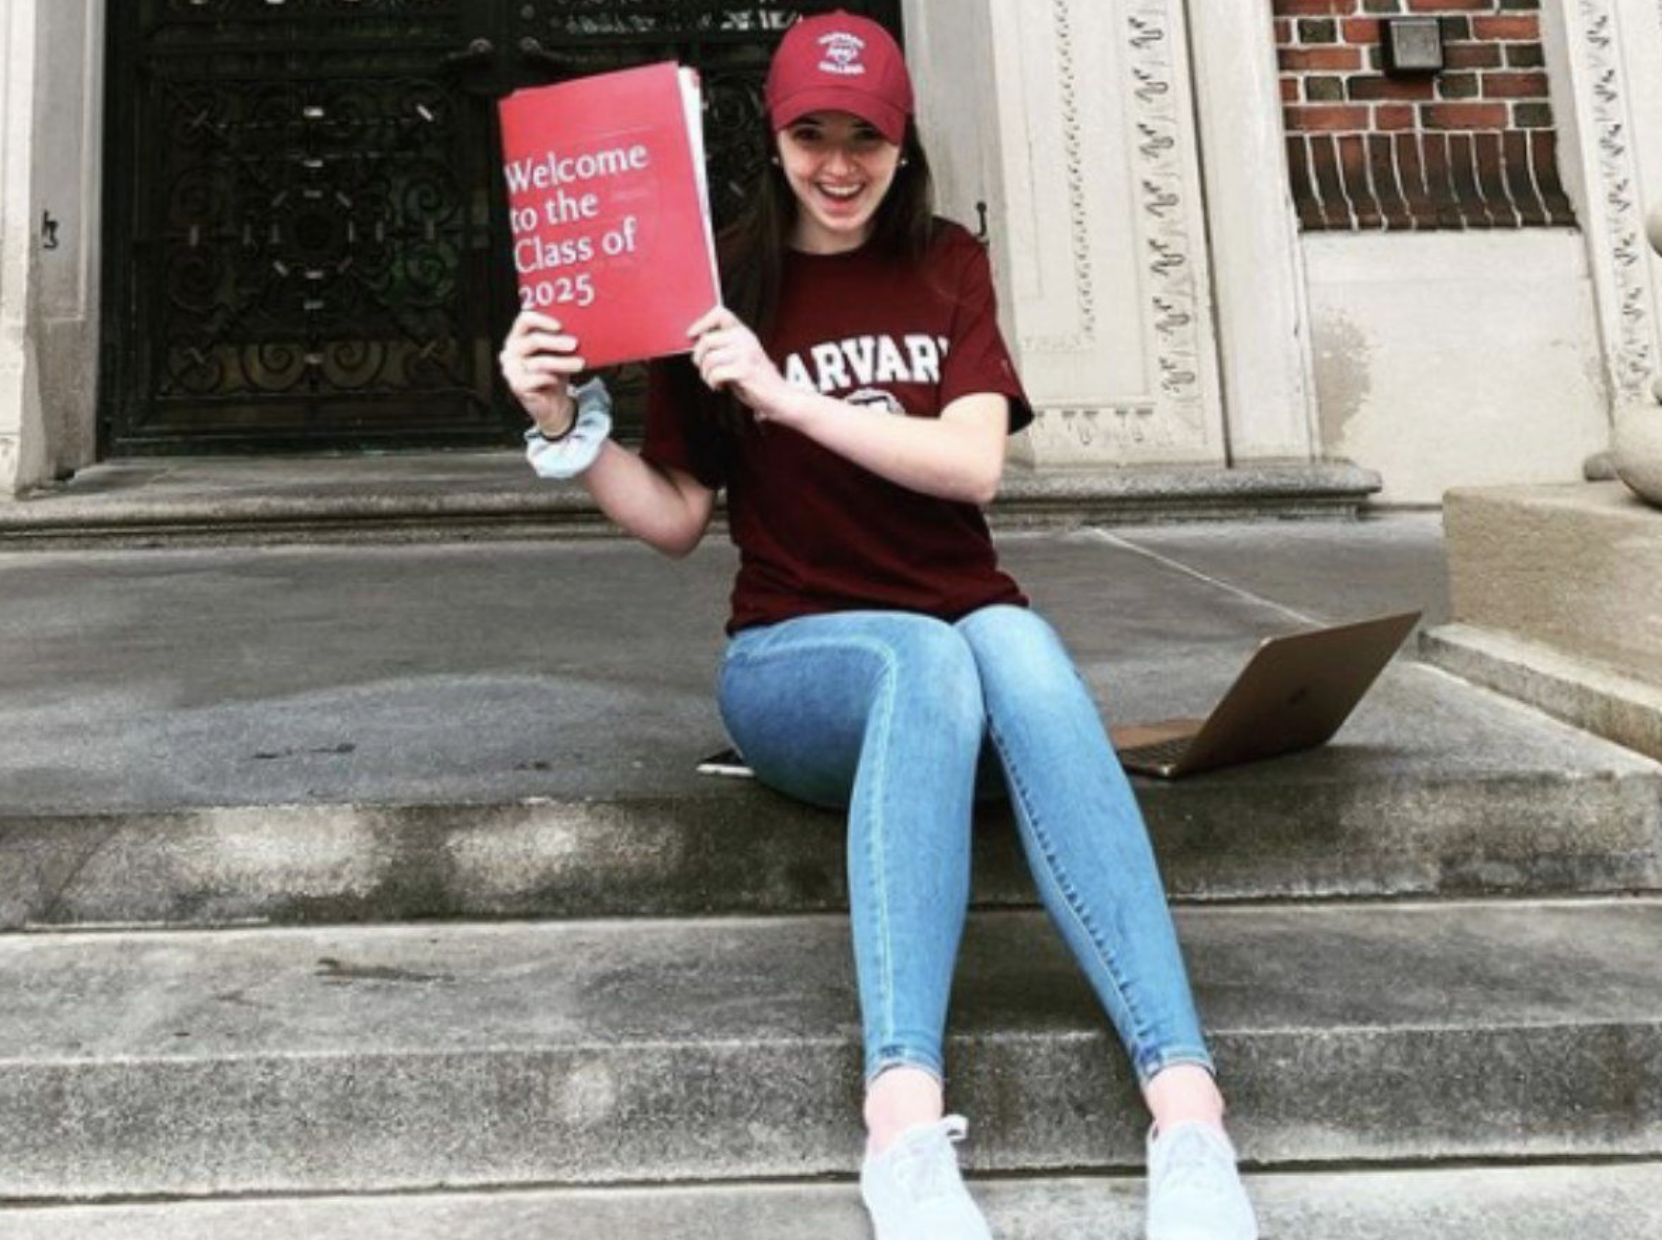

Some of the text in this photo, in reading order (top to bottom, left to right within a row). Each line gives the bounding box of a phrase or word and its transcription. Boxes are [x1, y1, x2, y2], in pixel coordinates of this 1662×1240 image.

[503, 144, 649, 193] Welcome
[509, 188, 599, 234] to the
[514, 214, 637, 274] Class of
[518, 272, 595, 309] 2025
[785, 334, 950, 394] ARVAR
